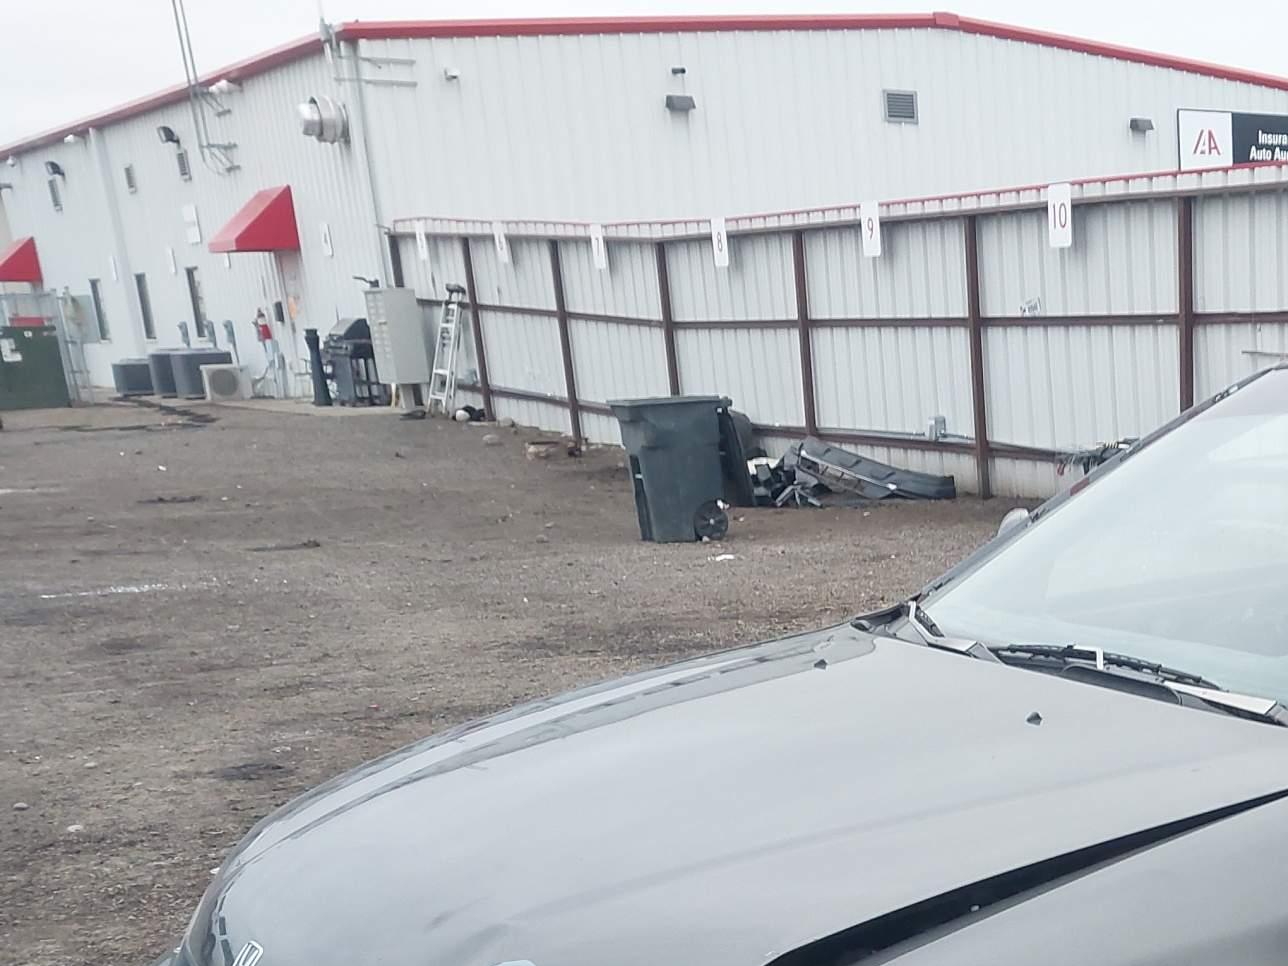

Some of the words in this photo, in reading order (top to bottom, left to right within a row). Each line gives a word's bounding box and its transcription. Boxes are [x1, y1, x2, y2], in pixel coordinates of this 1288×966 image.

[1249, 145, 1272, 161] Auto
[1053, 202, 1067, 229] 10
[867, 216, 874, 241] 9
[716, 230, 723, 252] 8
